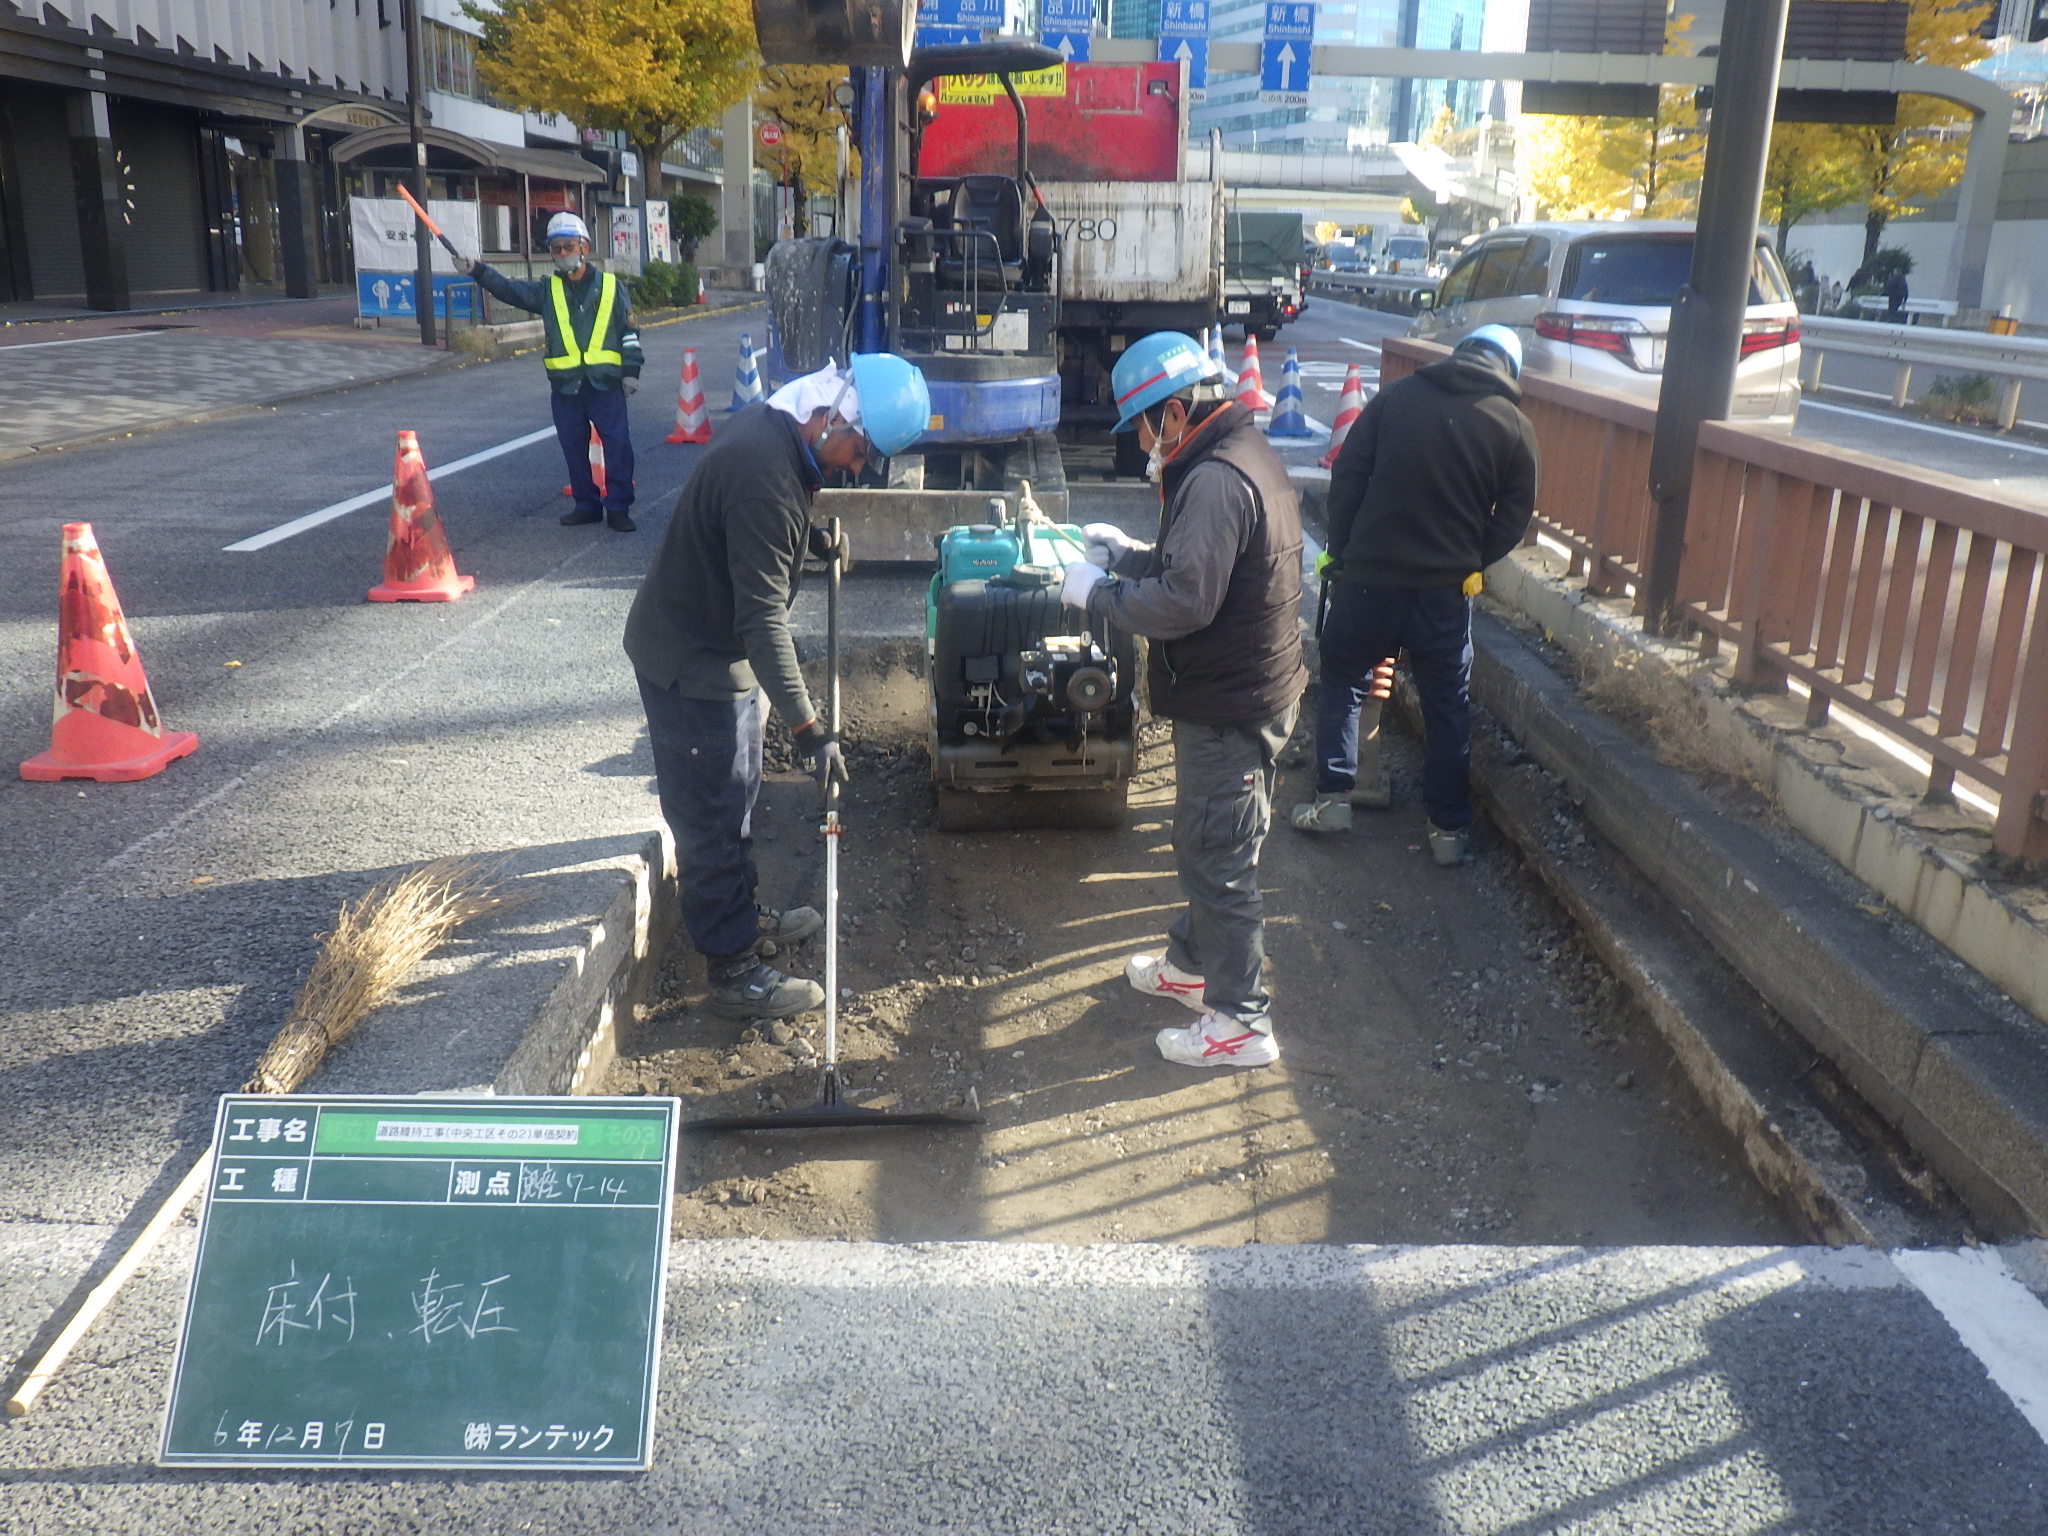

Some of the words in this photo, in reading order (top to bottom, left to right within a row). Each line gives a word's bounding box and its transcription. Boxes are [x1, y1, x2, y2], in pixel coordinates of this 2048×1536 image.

[957, 13, 1001, 24] Shinagawa
[1166, 2, 1205, 20] 新橋
[1270, 5, 1310, 24] 新橋
[1044, 15, 1089, 27] Shinagawa
[1164, 20, 1206, 31] Shinbashi
[1268, 24, 1312, 34] Shinbashi
[1057, 217, 1117, 241] 780
[231, 1116, 307, 1143] 工事名
[454, 1170, 511, 1196] 測点
